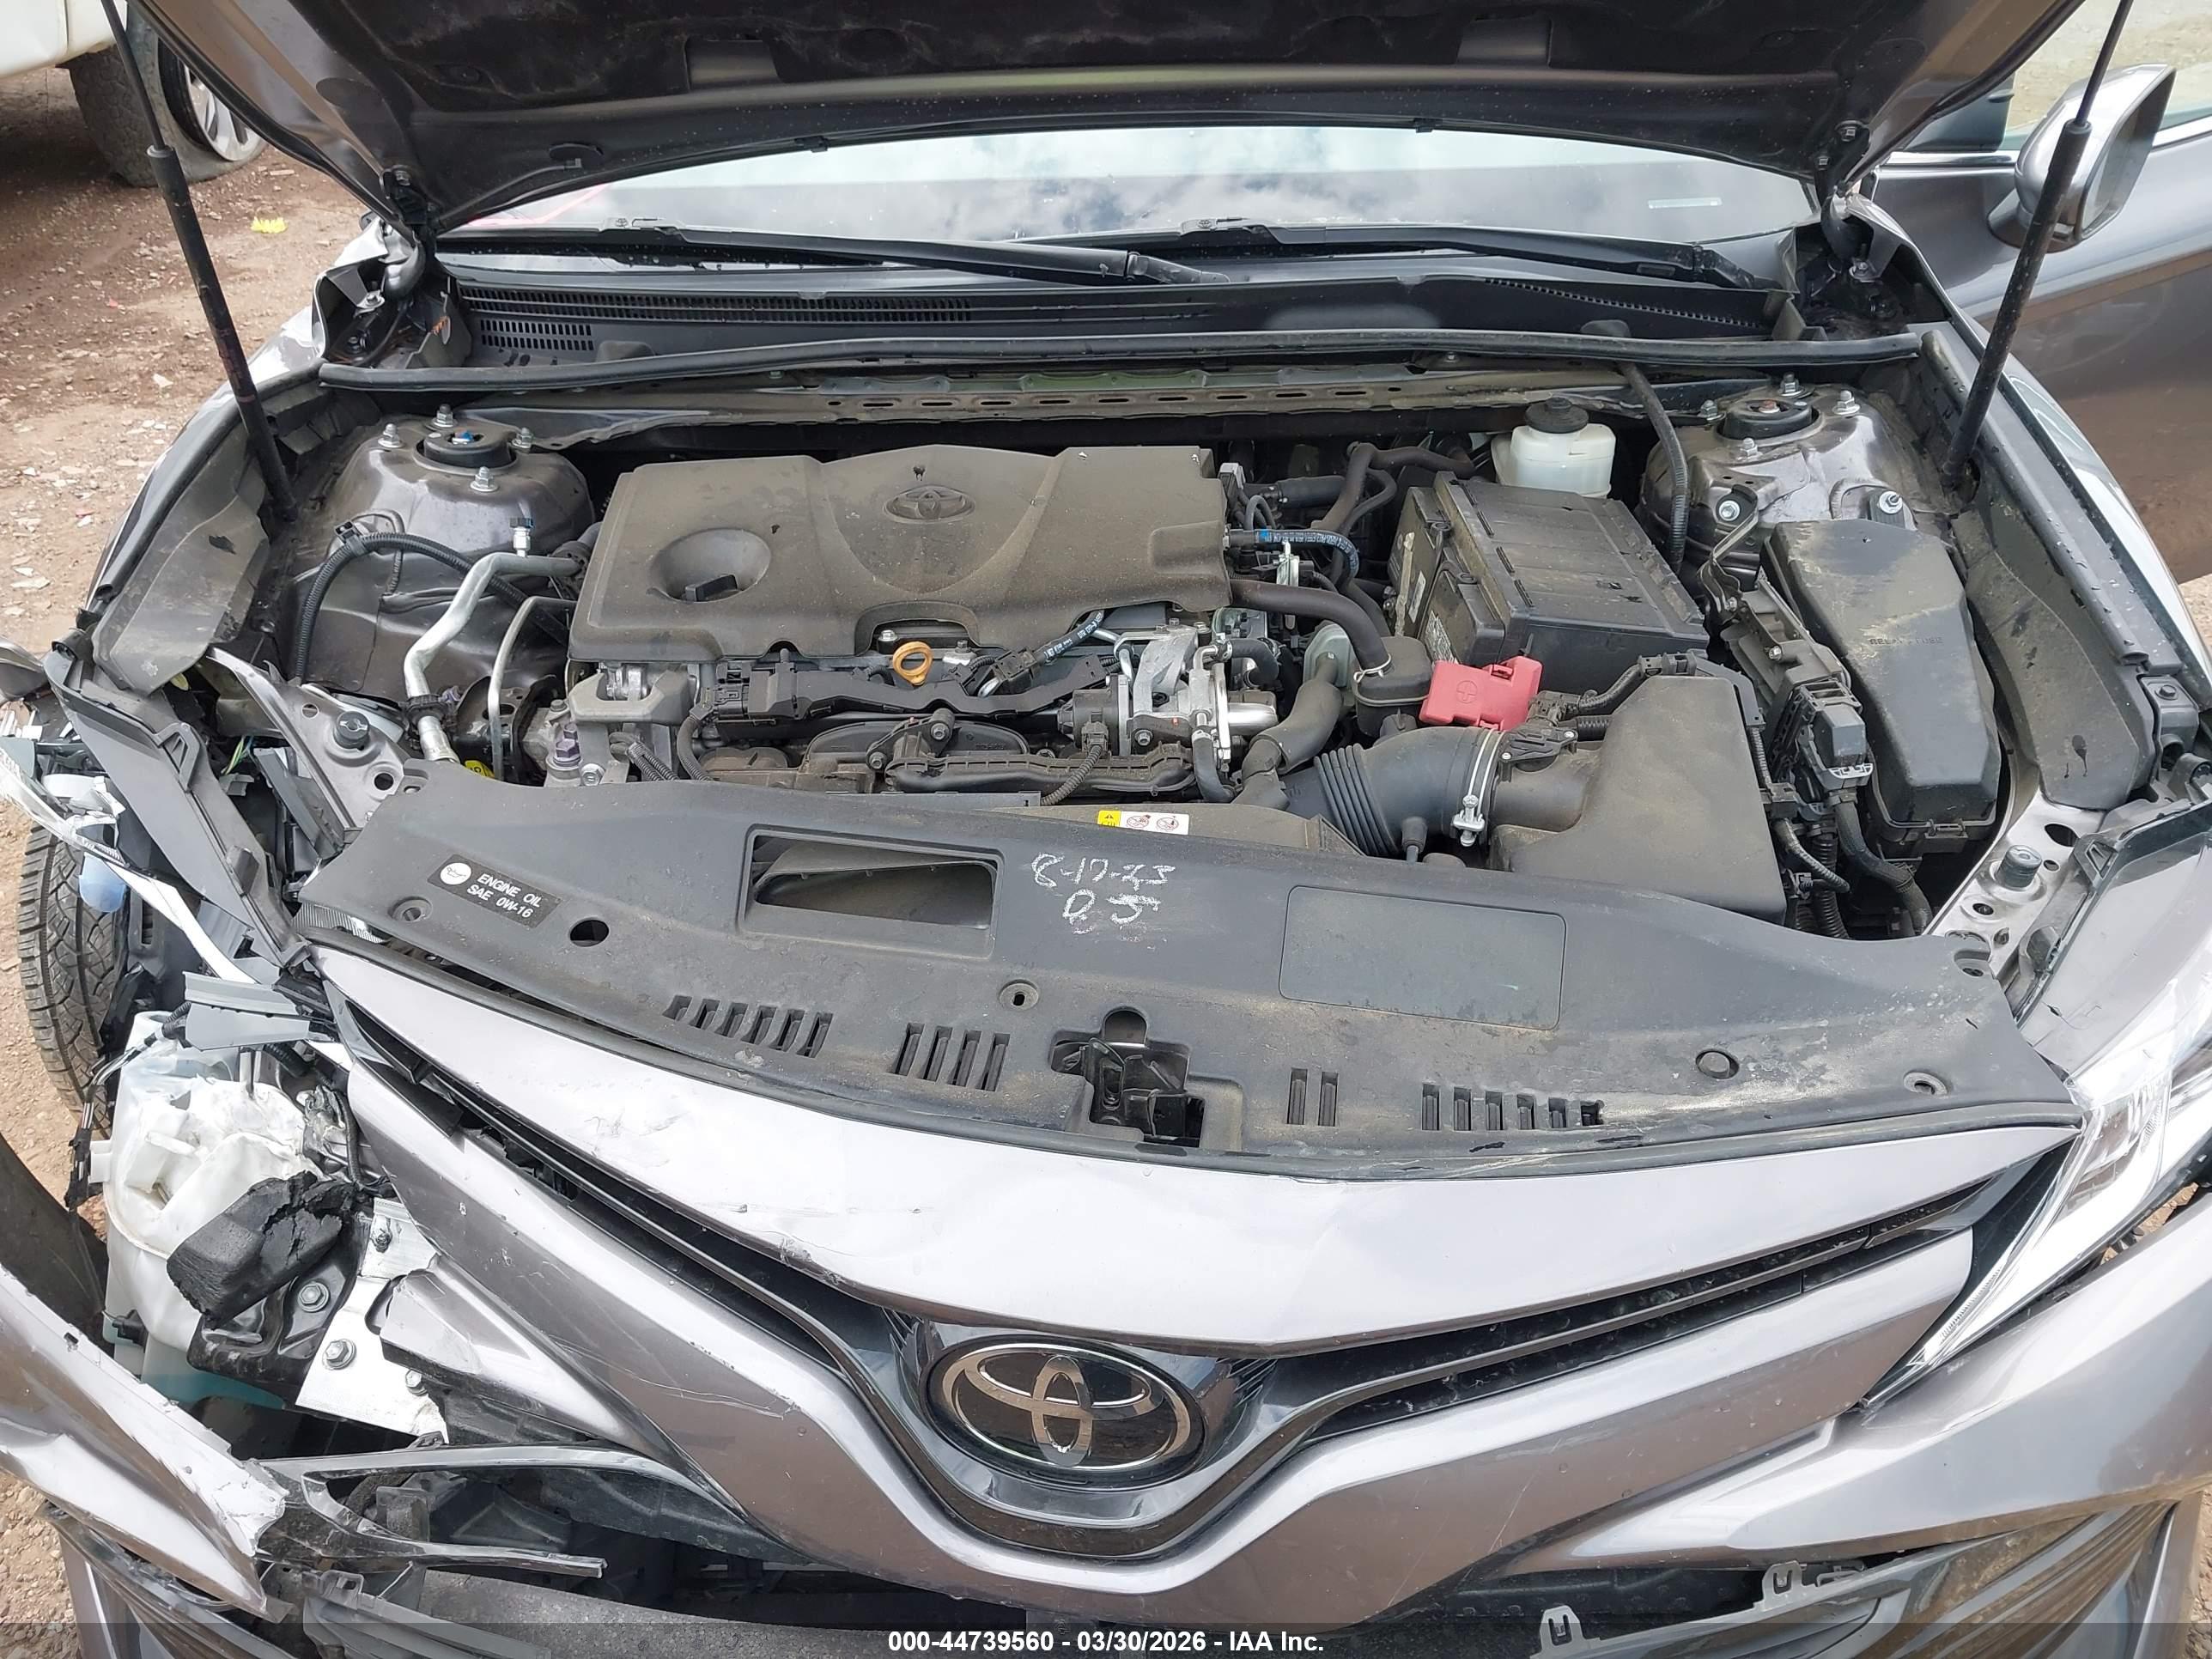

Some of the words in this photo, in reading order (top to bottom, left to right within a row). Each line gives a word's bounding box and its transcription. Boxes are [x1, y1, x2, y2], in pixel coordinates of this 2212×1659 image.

[466, 884, 494, 901] SAE
[495, 896, 534, 919] 0W-16
[477, 873, 521, 897] ENGINE
[523, 893, 545, 908] OIL
